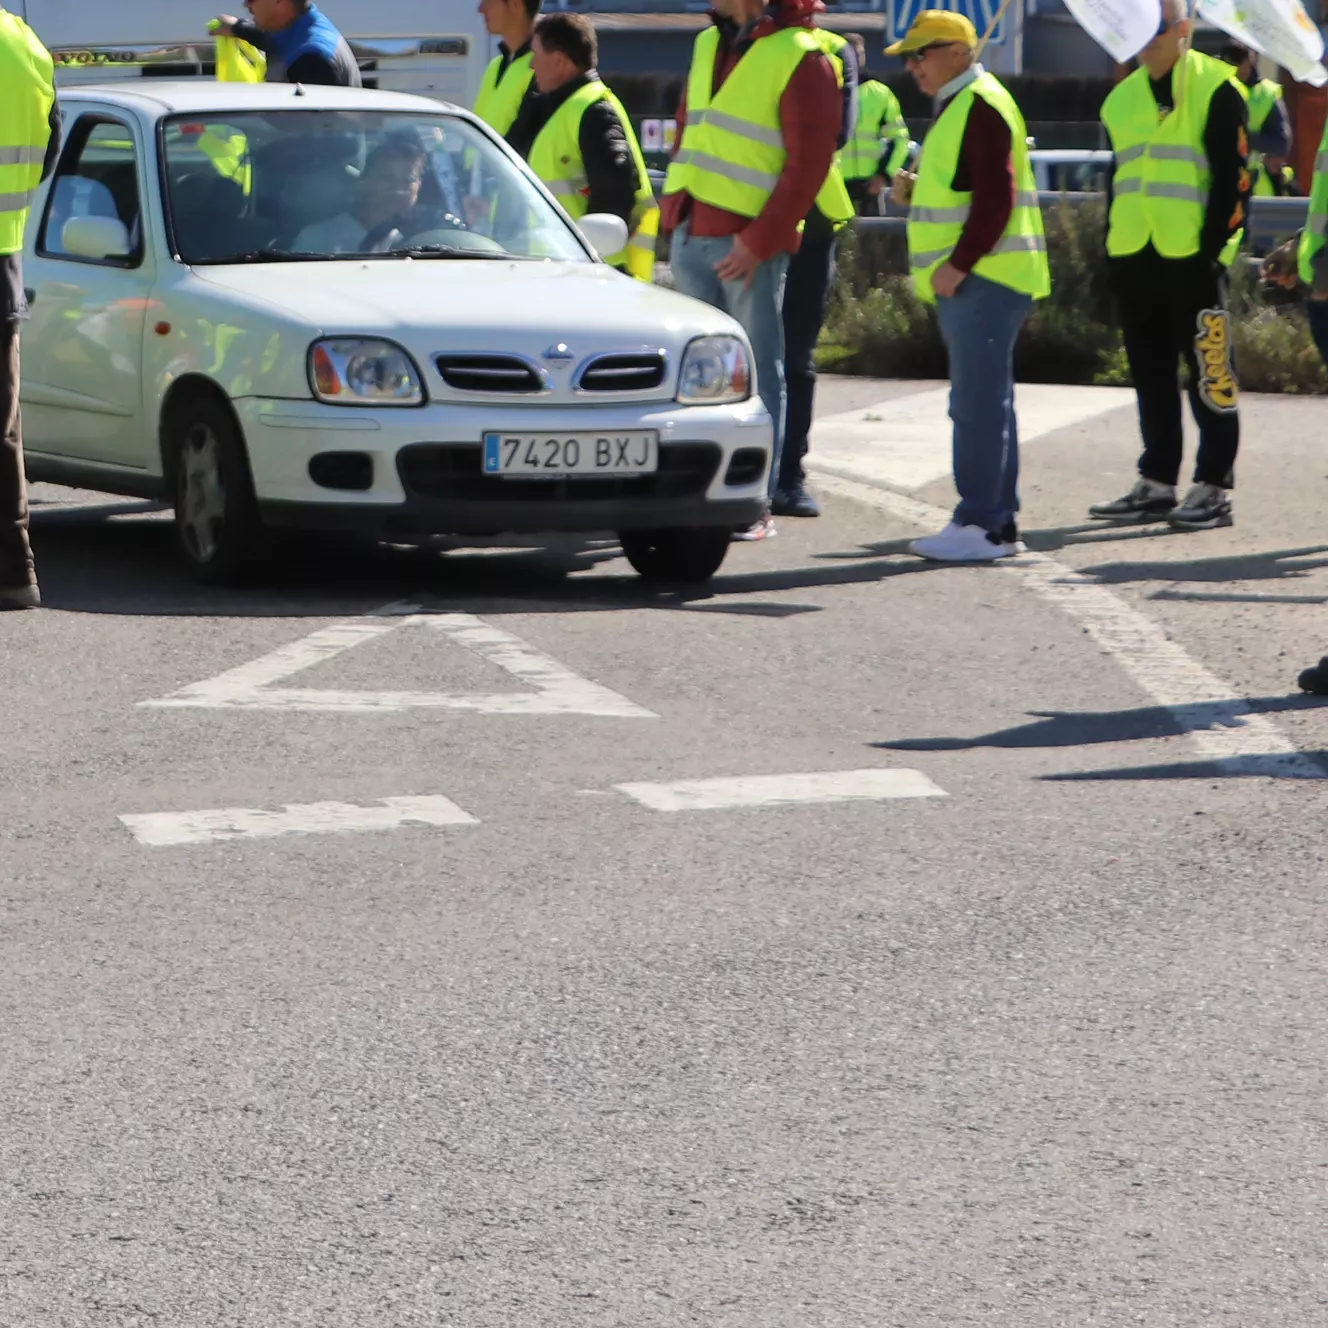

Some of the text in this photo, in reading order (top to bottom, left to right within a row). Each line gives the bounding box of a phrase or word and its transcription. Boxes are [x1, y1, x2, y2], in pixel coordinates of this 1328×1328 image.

[1195, 314, 1241, 409] Cheetos
[504, 437, 650, 468] 7420 BXJ
